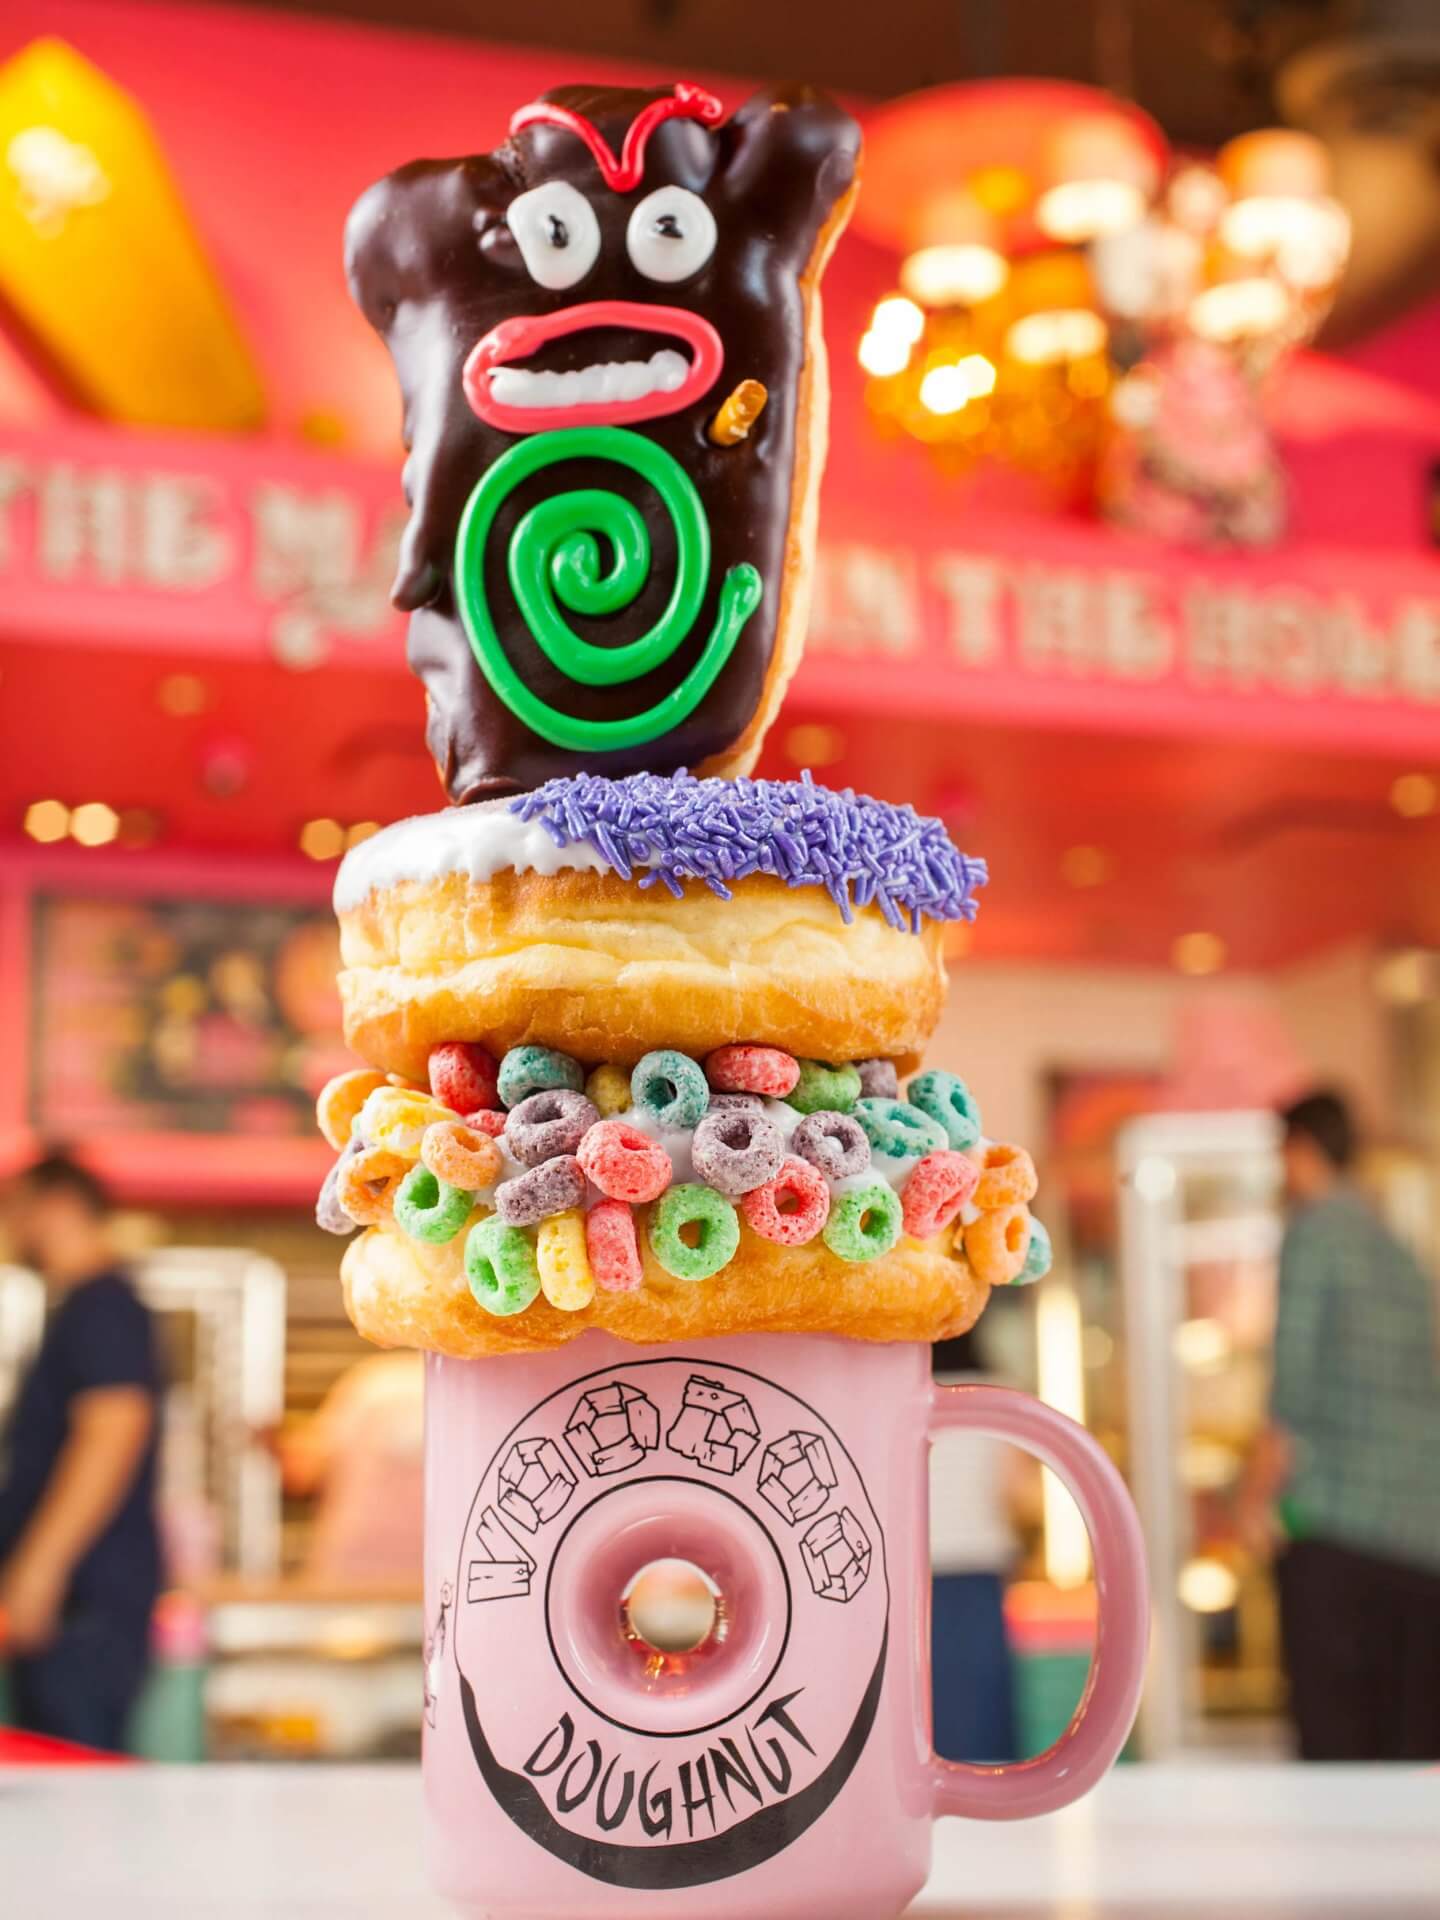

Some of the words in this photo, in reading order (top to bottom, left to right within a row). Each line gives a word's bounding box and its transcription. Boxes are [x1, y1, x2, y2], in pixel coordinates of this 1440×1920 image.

[932, 555, 1174, 678] THE
[468, 1374, 873, 1603] VOODOO
[523, 1687, 817, 1840] DOUGHNUT
